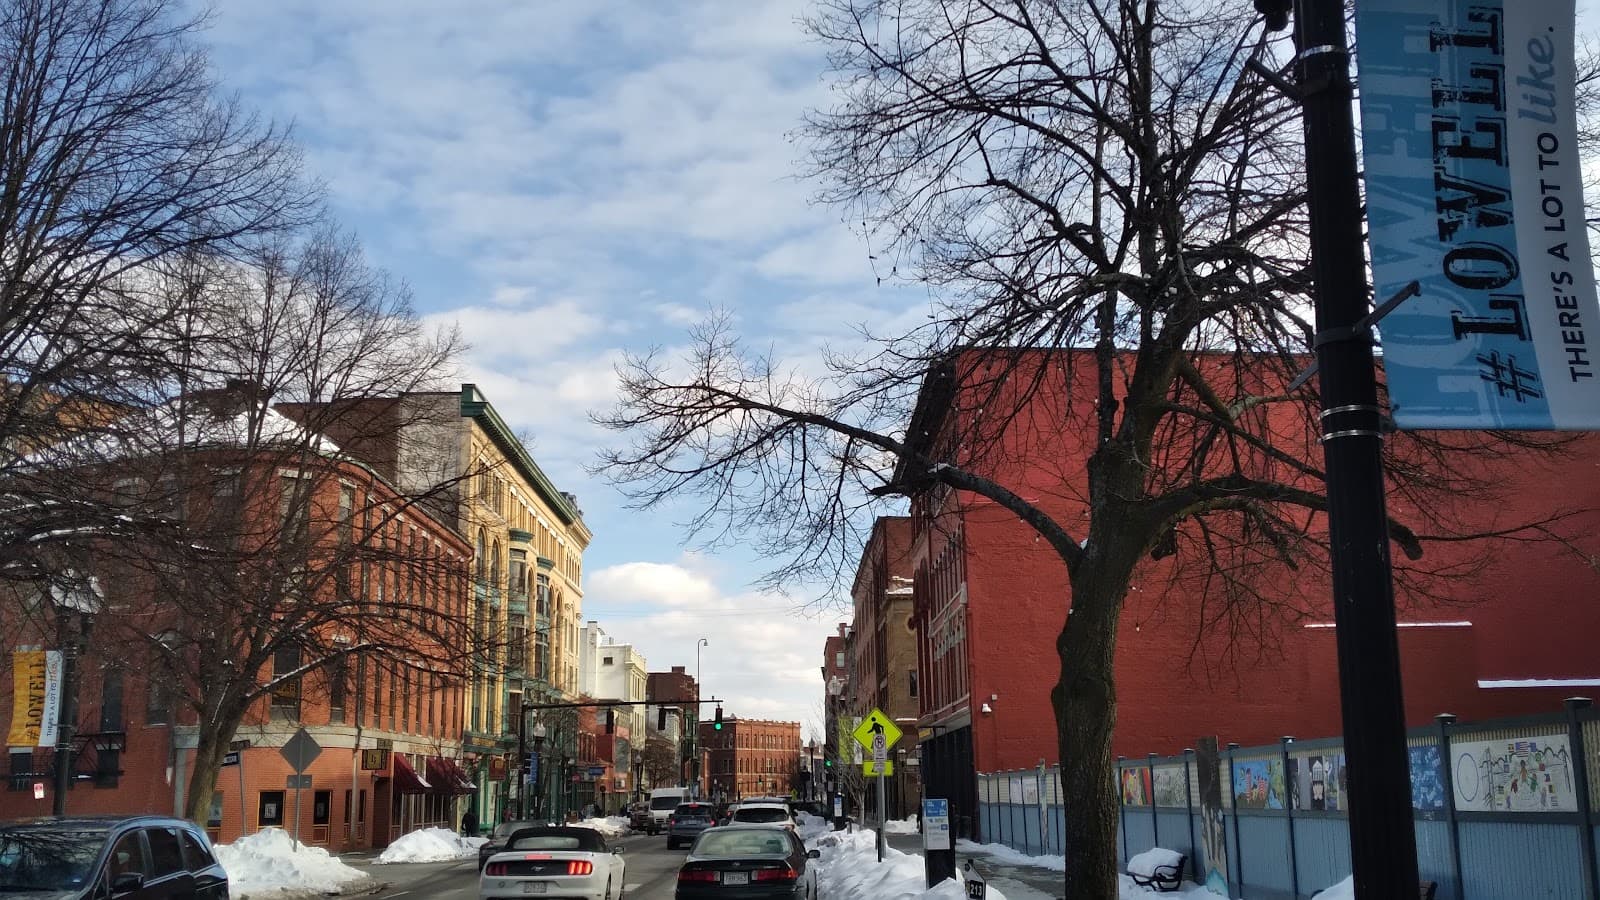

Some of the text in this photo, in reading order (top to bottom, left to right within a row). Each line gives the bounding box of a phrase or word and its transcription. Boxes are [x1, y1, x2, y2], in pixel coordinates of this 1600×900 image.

[1429, 6, 1543, 403] #LOWELL
[1516, 25, 1592, 383] THERE'S A LOT TO like.
[970, 884, 983, 896] 213
